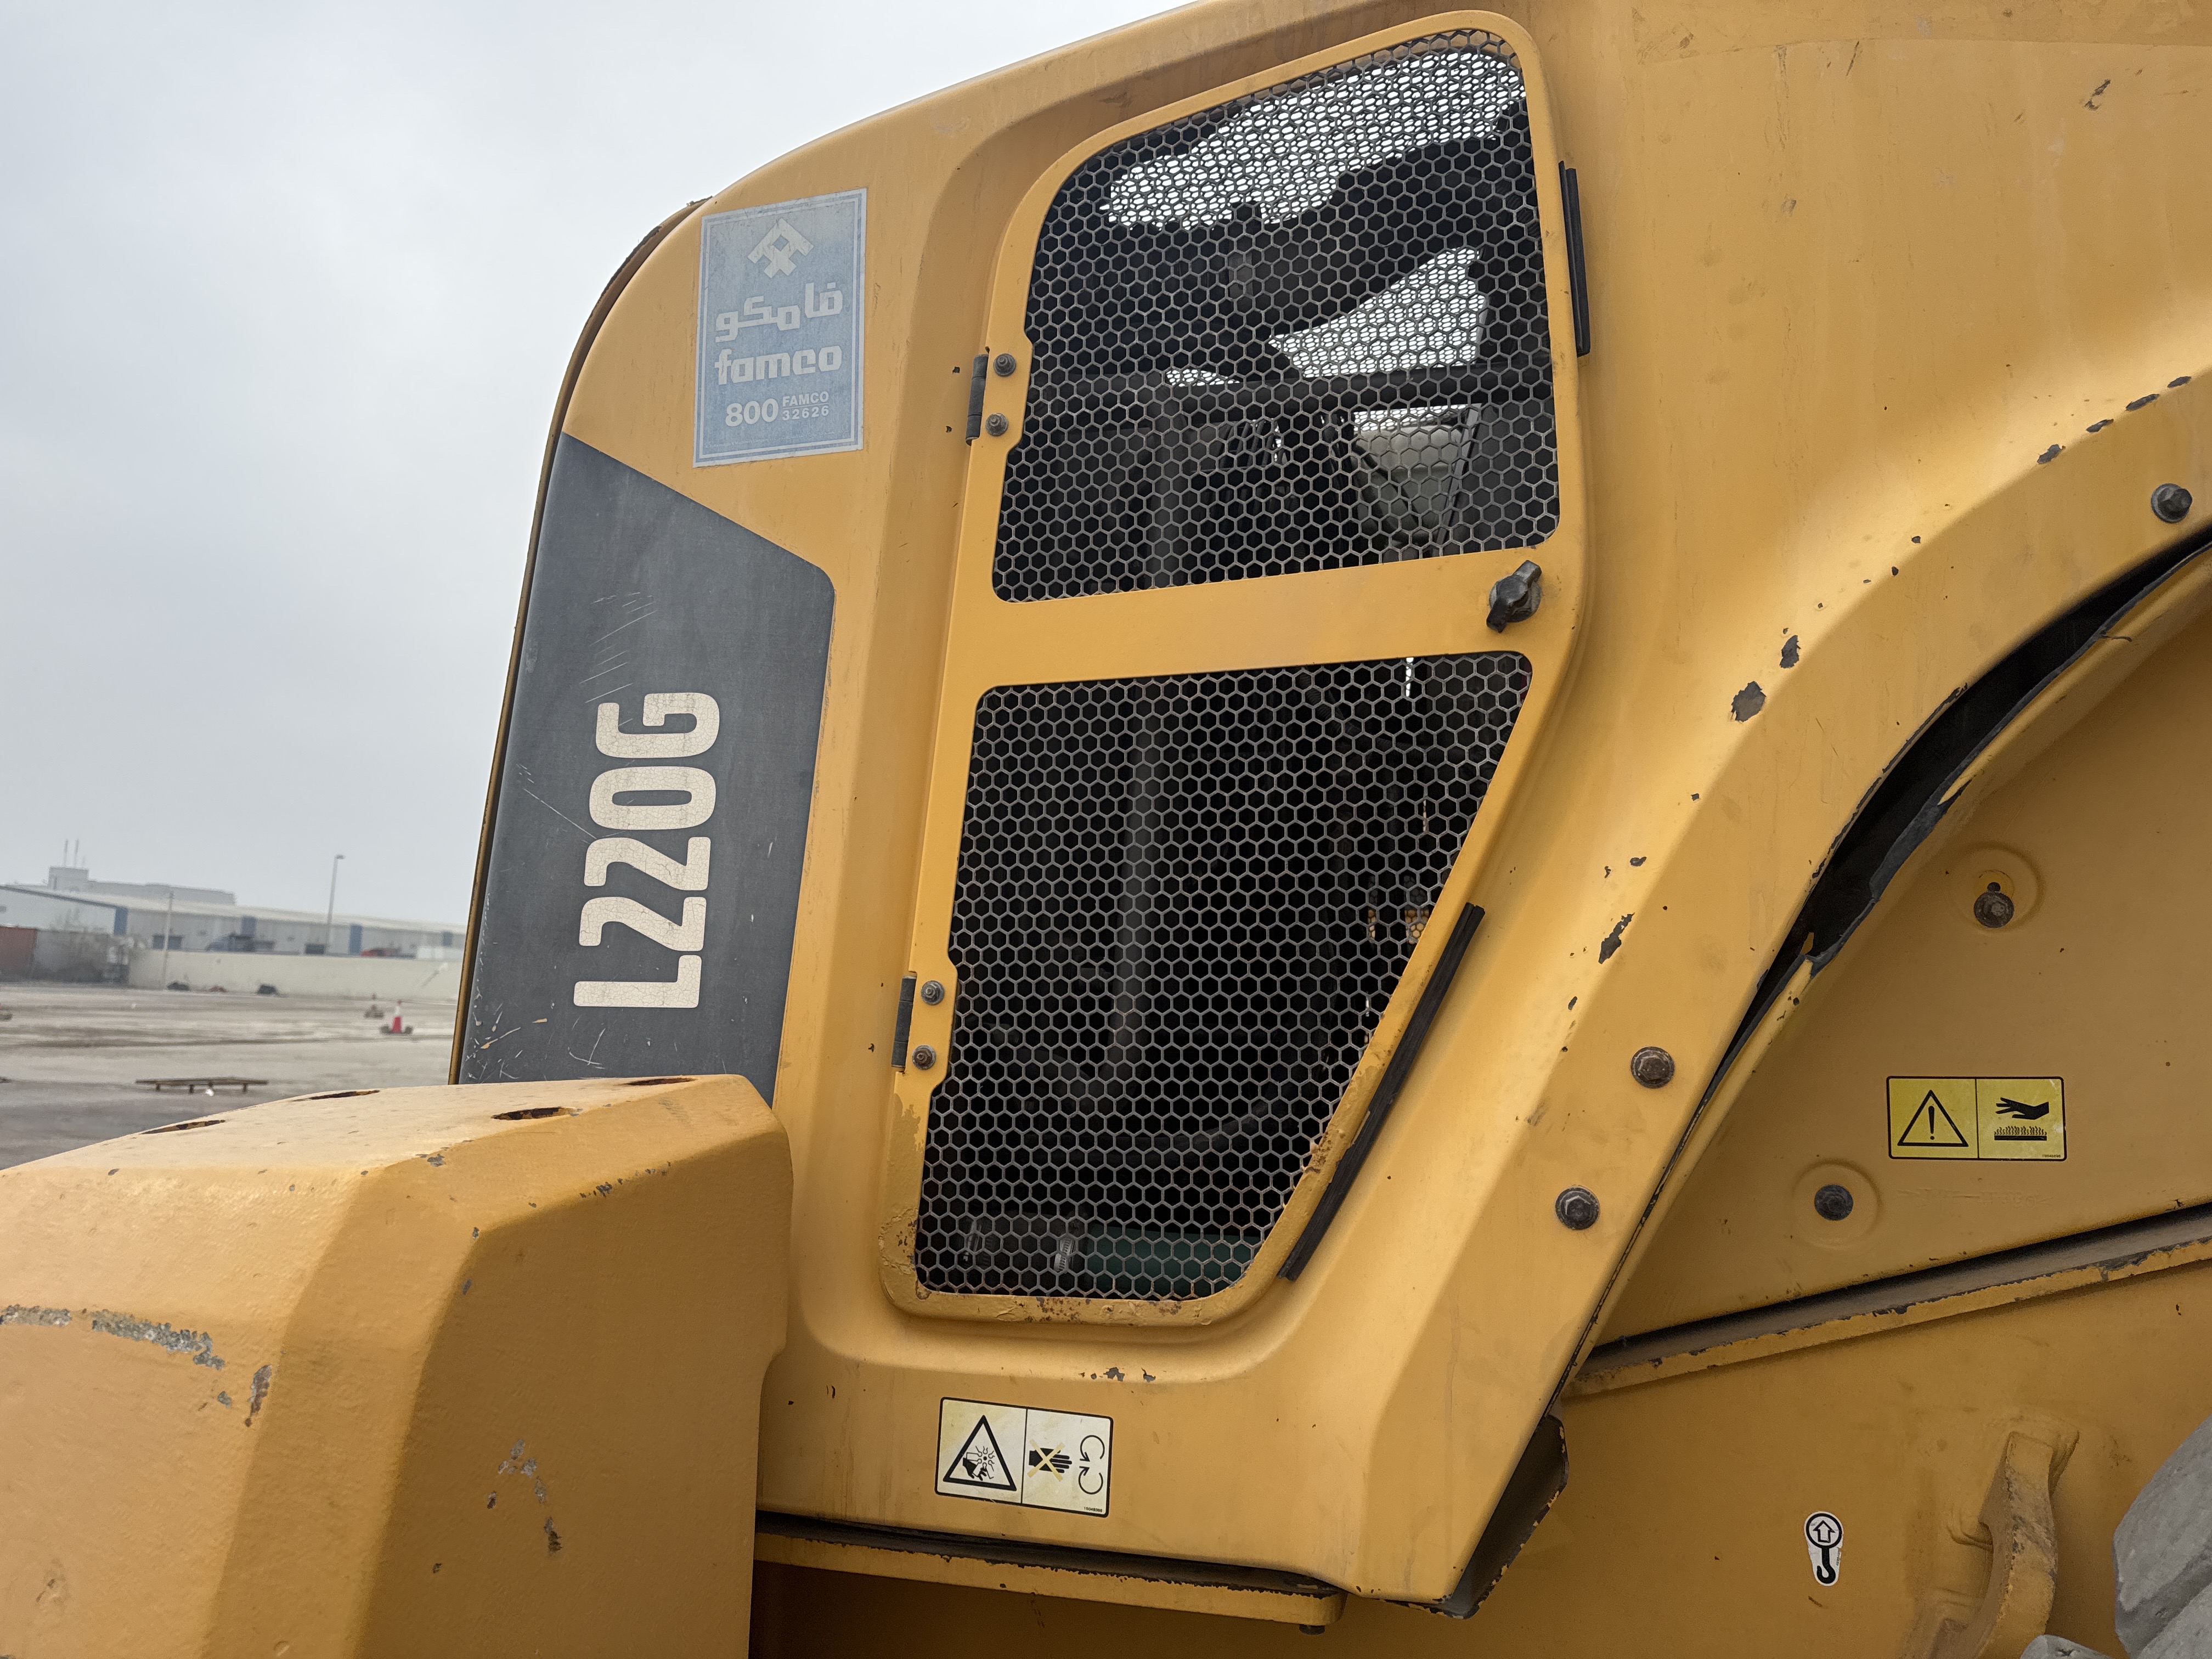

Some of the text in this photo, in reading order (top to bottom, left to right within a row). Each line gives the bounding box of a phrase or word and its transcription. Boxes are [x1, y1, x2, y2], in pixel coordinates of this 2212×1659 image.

[715, 282, 843, 343] فامكو
[715, 346, 843, 385] famco
[725, 391, 830, 427] 800 FAMCO
[782, 405, 830, 421] 32626
[573, 692, 720, 1008] L220G
